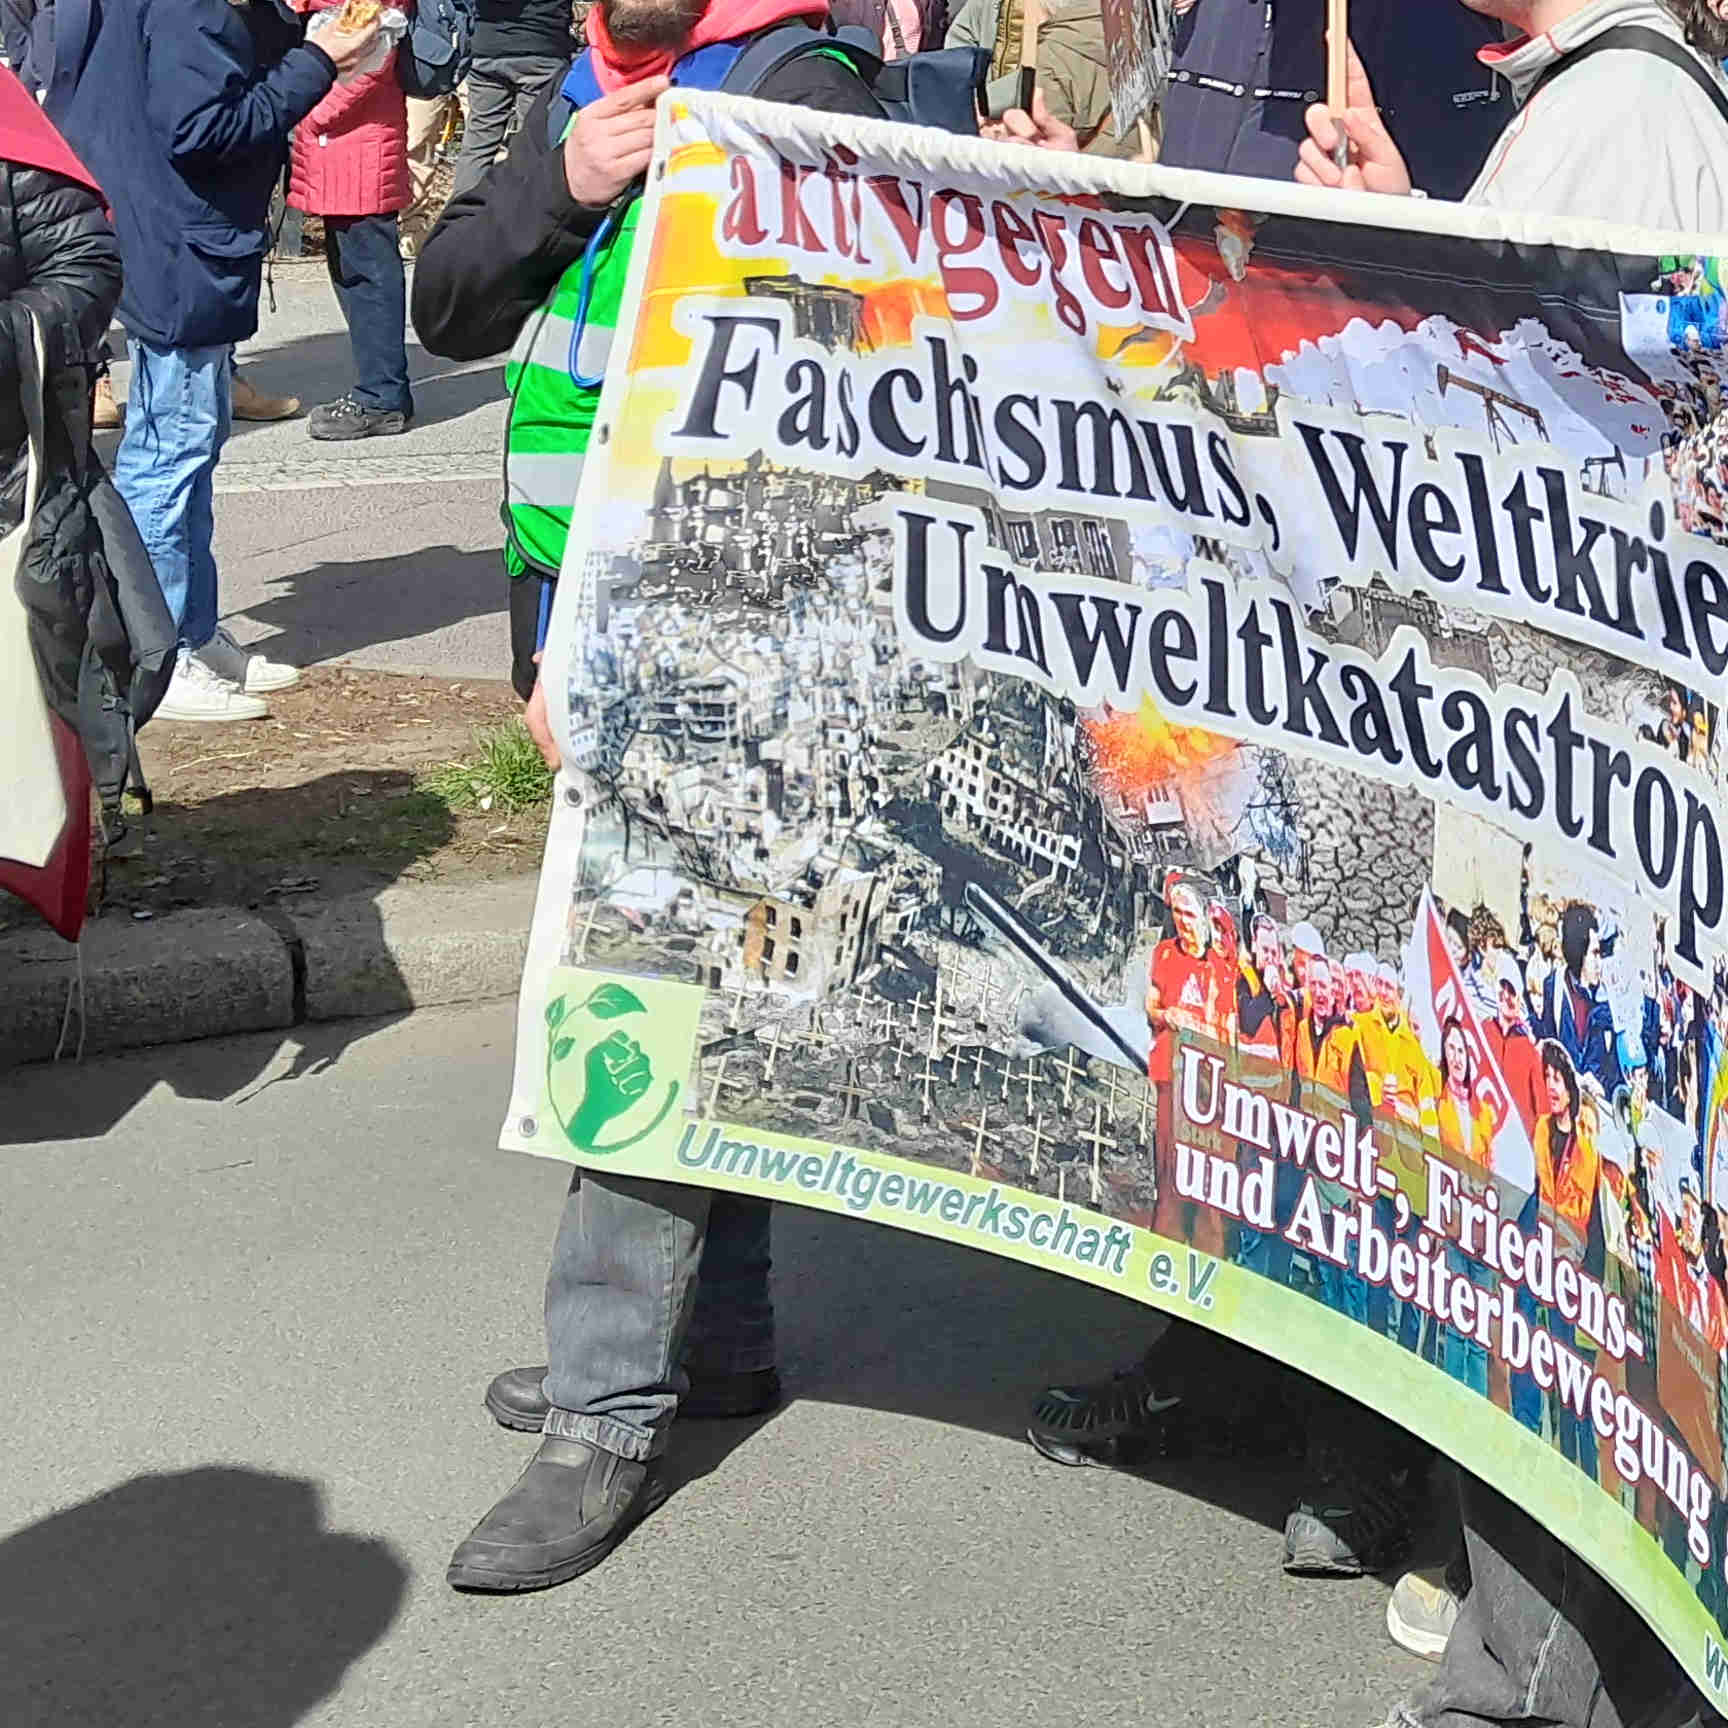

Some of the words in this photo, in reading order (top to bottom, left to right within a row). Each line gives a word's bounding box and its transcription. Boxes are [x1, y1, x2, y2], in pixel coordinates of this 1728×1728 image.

[672, 314, 1282, 551] Faschismus,
[677, 1123, 1133, 1276] Umweltgewerkschaft
[1149, 1250, 1219, 1310] e.V.
[1423, 1151, 1645, 1361] Friedens-
[1174, 1140, 1276, 1231] und
[1285, 1173, 1713, 1567] Arbeiterbewegung
